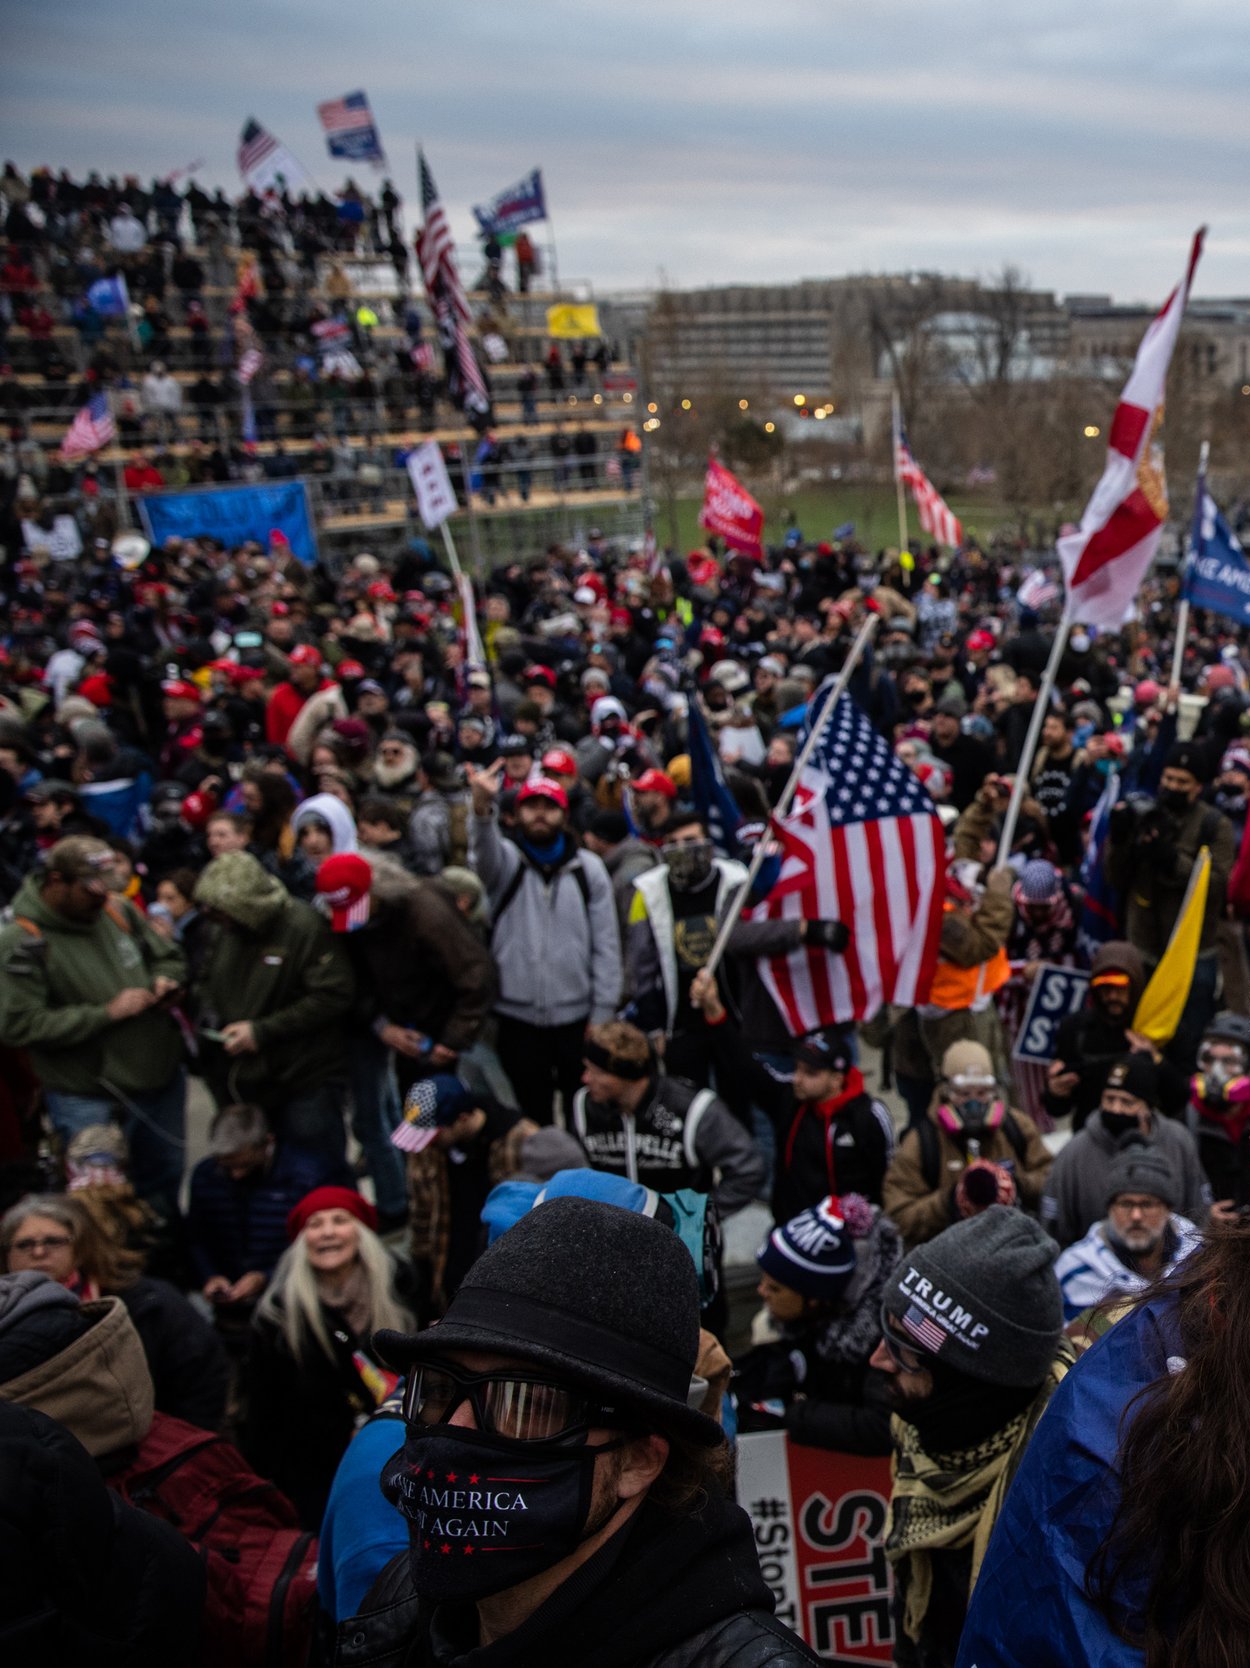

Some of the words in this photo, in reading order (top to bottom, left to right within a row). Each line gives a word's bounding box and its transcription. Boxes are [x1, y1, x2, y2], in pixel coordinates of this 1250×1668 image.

[1040, 973, 1090, 1015] ST
[1024, 1015, 1054, 1054] S
[785, 1207, 842, 1257] UMP
[904, 1266, 990, 1339] TRUMP
[418, 1485, 529, 1511] AMERICA
[430, 1517, 511, 1538] AGAIN
[801, 1489, 897, 1664] STE
